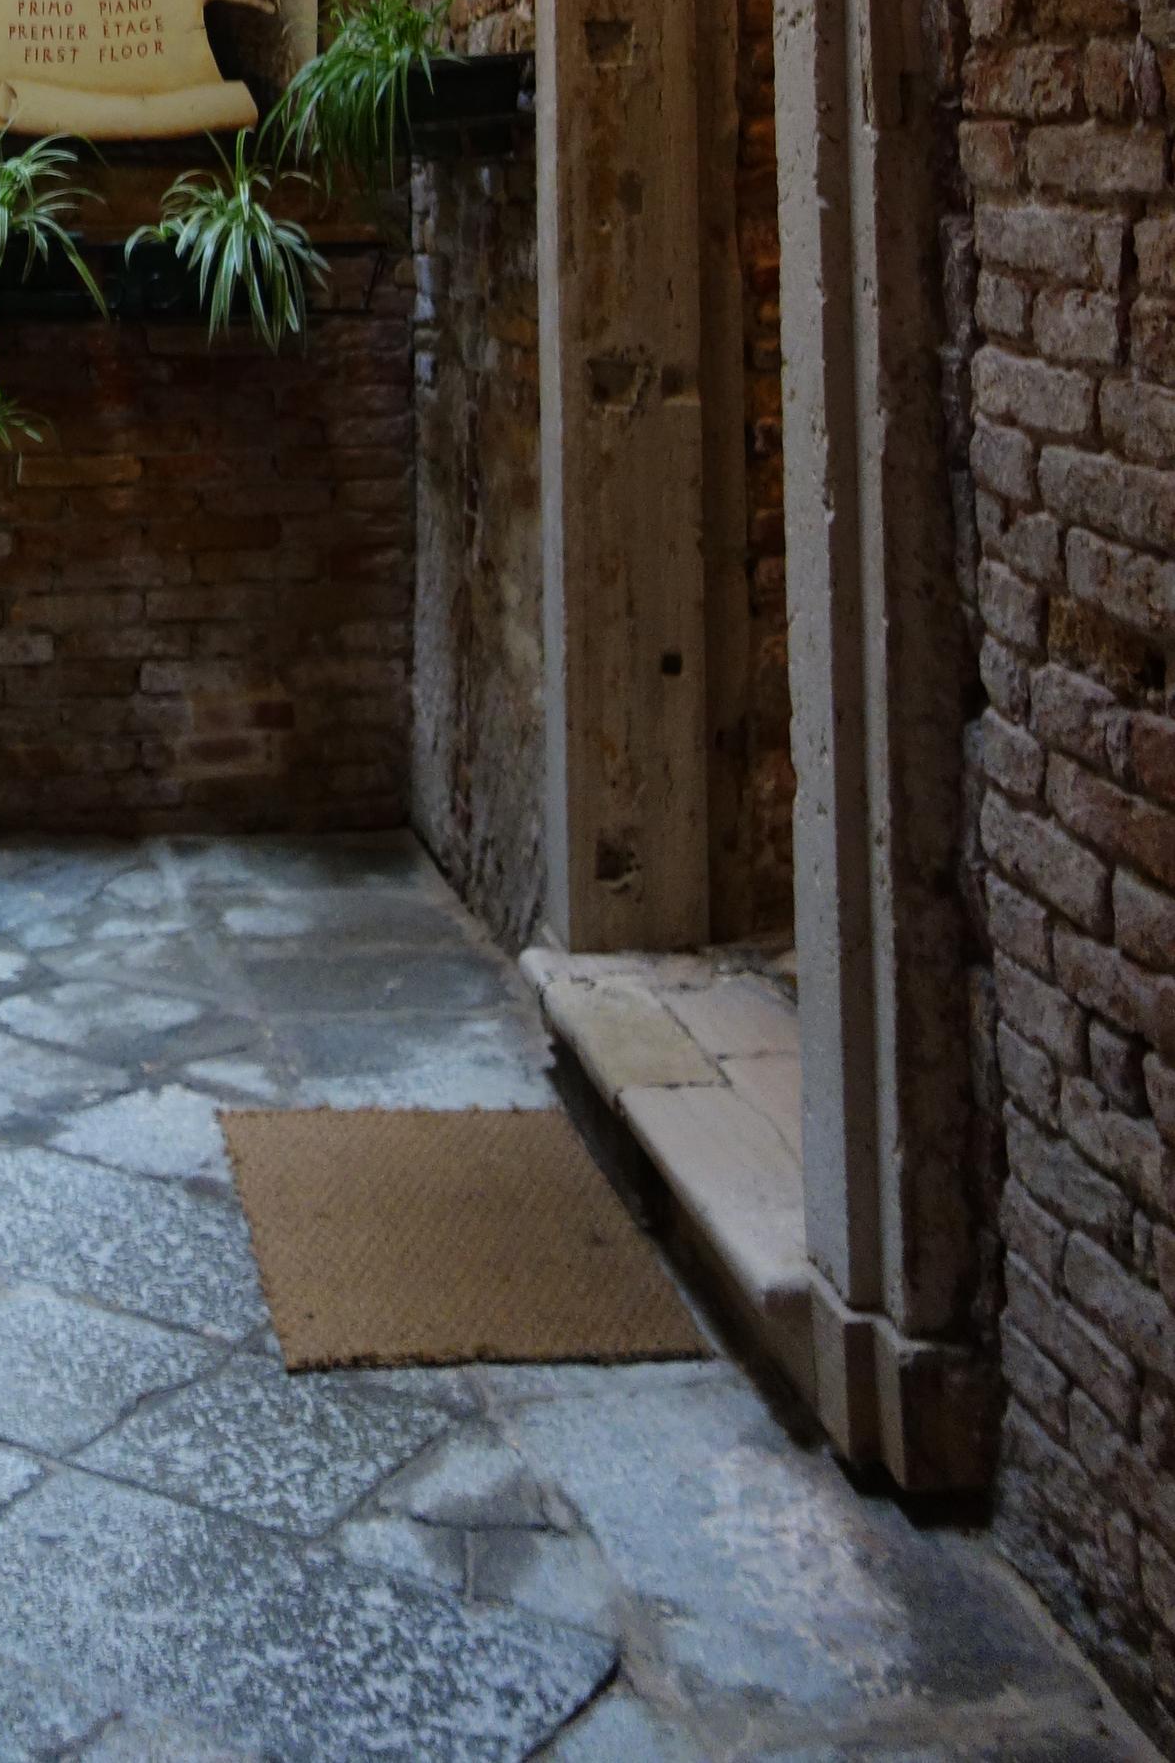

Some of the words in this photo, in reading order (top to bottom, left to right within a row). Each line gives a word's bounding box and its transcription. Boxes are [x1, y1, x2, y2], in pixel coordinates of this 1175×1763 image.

[17, 0, 74, 17] PRIMO
[8, 23, 89, 41] PREMIER
[24, 45, 80, 64] FIRST
[99, 38, 165, 64] FLOOR
